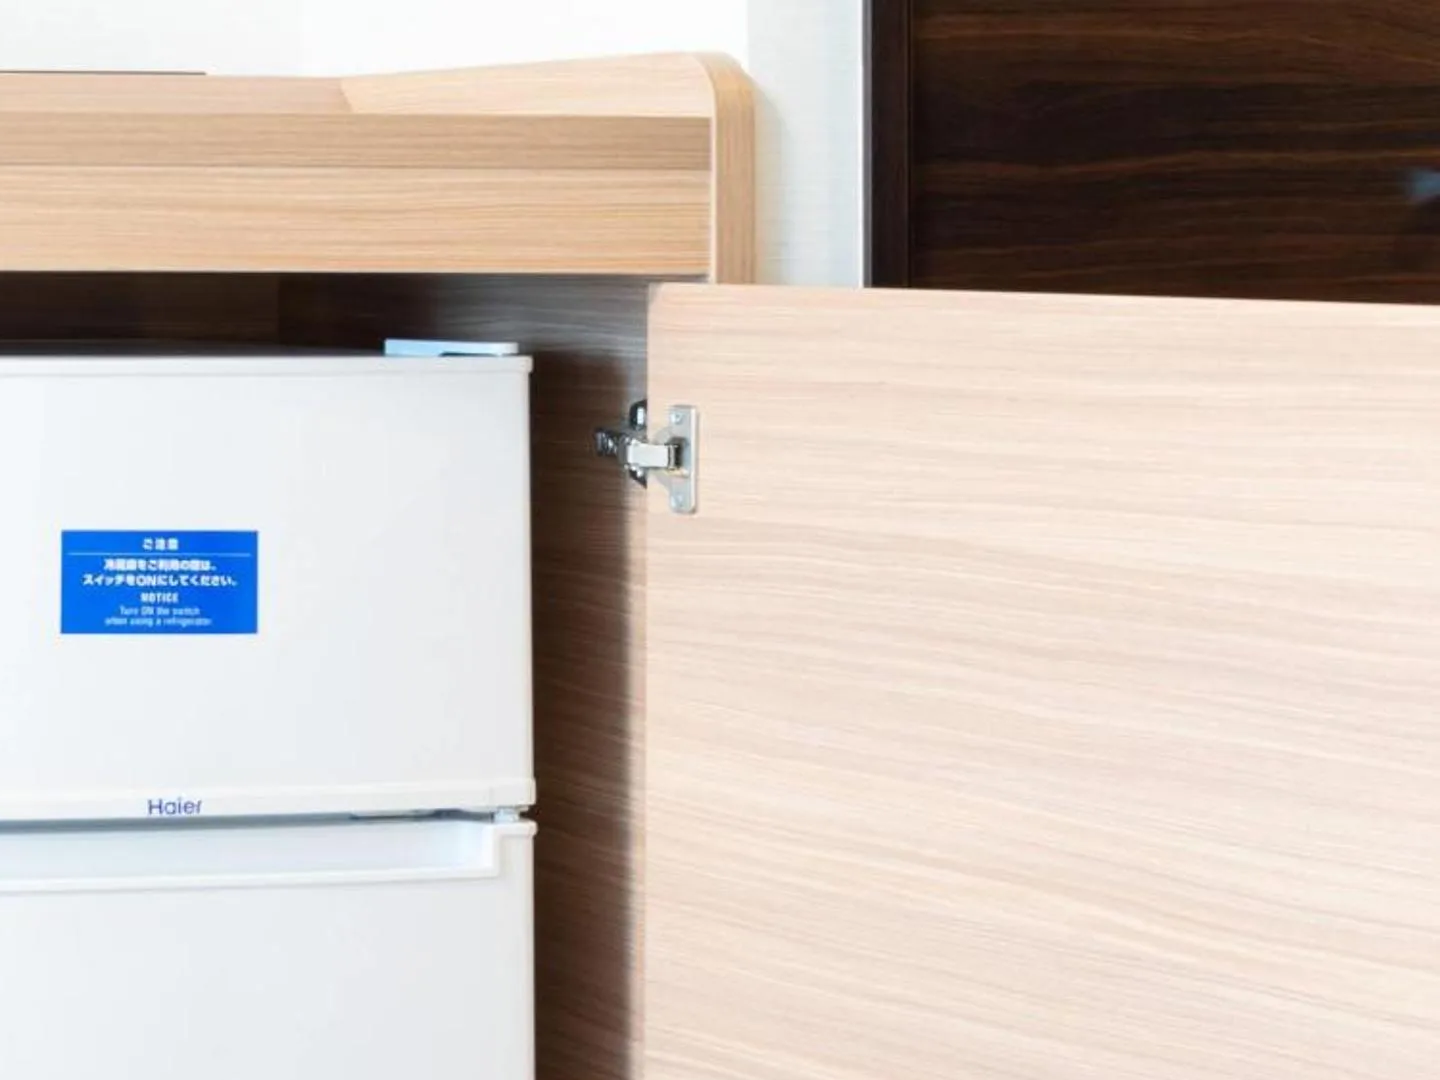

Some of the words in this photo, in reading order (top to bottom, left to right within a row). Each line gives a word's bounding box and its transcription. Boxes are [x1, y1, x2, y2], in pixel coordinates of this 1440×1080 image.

[142, 538, 179, 551] ご注意
[83, 574, 238, 587] スイッチをONにしてください。
[141, 592, 179, 603] NOTICE
[120, 606, 138, 615] Turn
[157, 606, 170, 615] the
[148, 797, 202, 814] Haier
